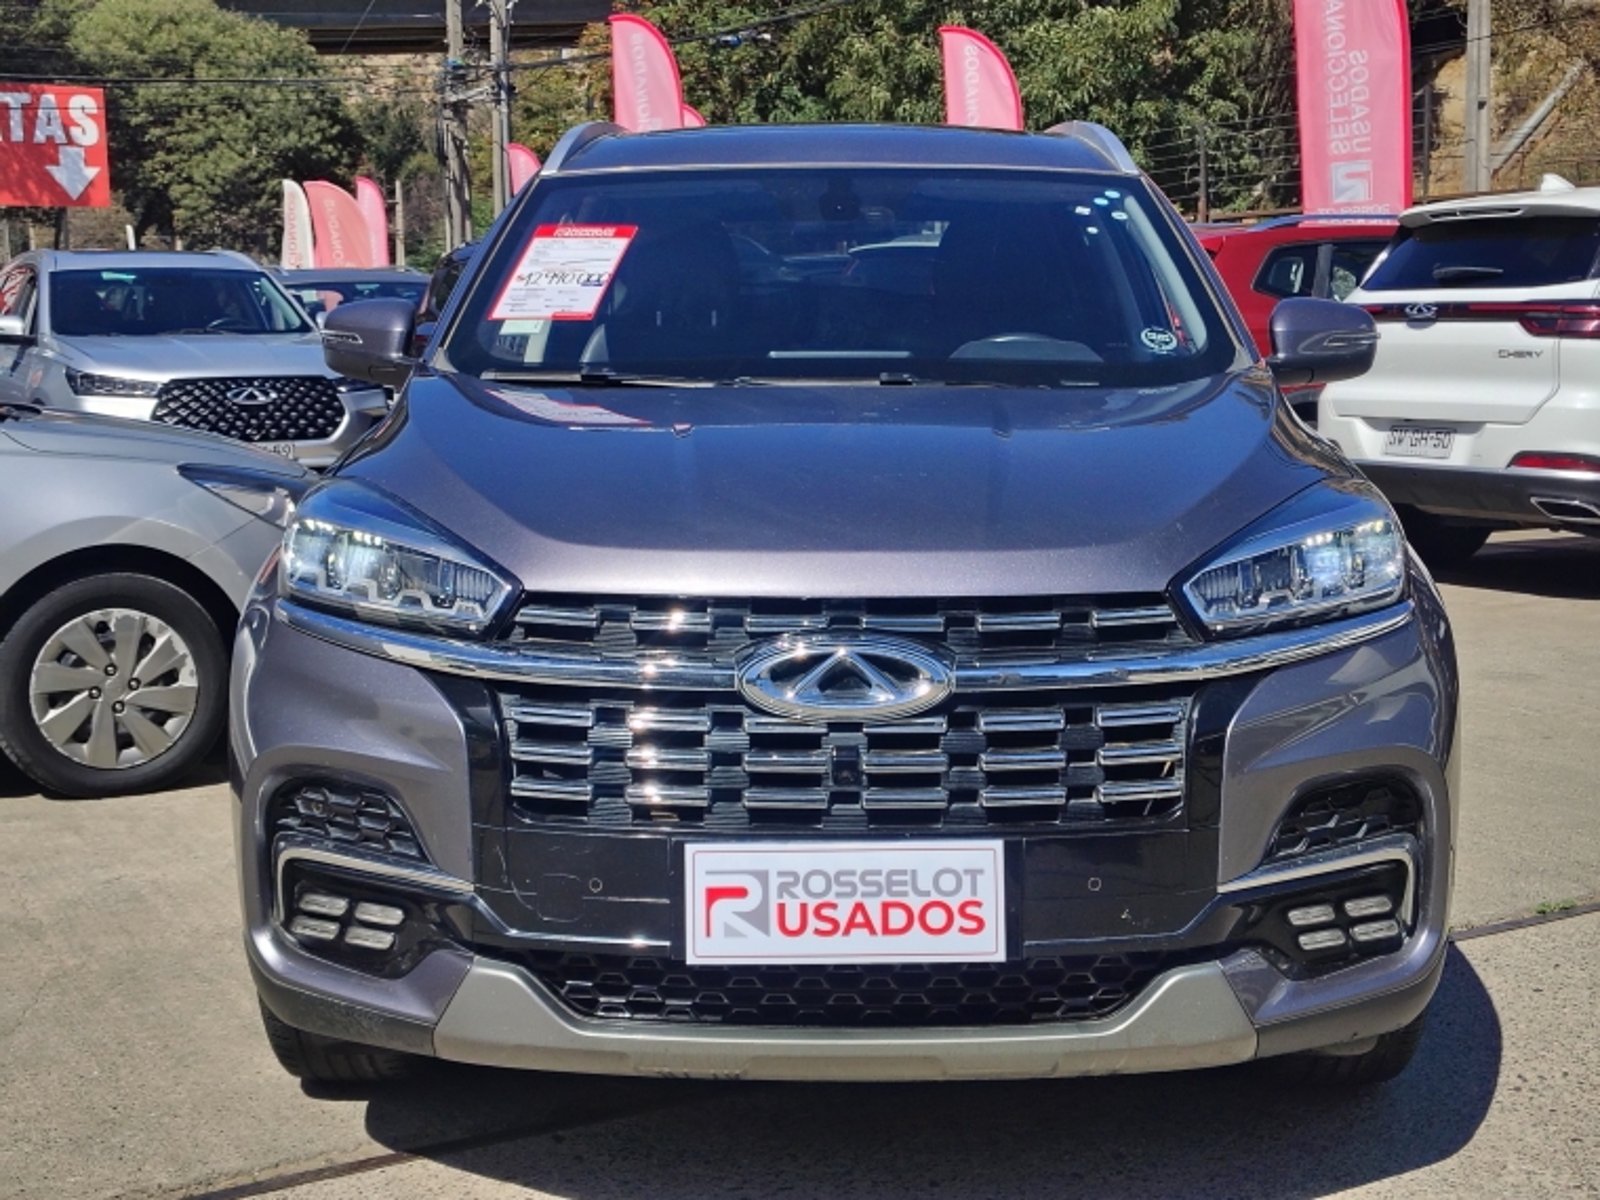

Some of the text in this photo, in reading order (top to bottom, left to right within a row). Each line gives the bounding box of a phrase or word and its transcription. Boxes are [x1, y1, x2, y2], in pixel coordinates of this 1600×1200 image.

[0, 92, 100, 147] TAS
[776, 867, 985, 899] ROSSELOT
[776, 900, 987, 937] USADOS
